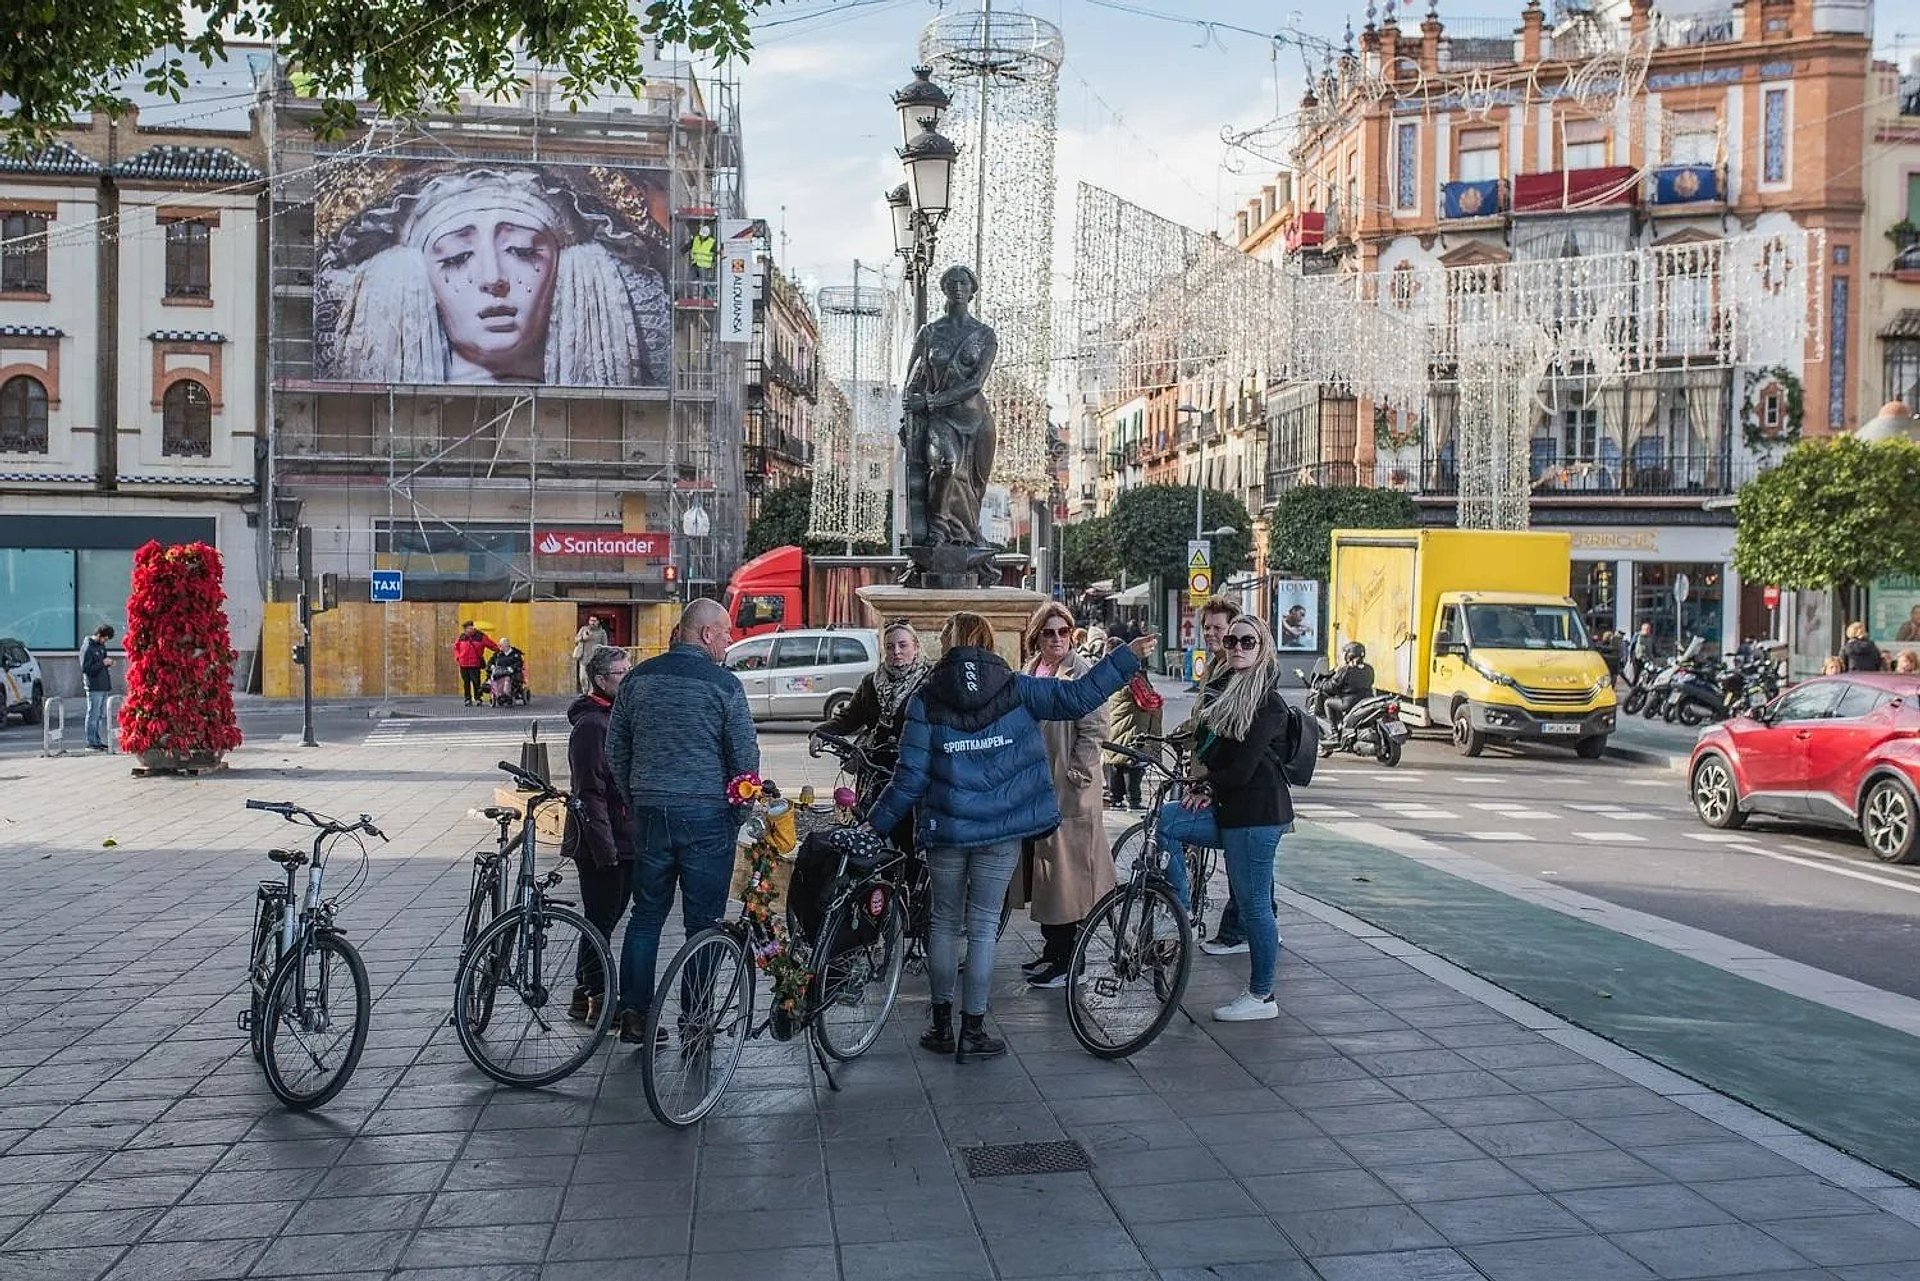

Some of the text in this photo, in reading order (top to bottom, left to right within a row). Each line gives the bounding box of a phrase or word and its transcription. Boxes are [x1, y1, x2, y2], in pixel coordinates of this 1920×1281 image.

[732, 275, 743, 334] ALQUIANSA
[564, 537, 655, 553] Santander
[373, 580, 401, 590] TAXI
